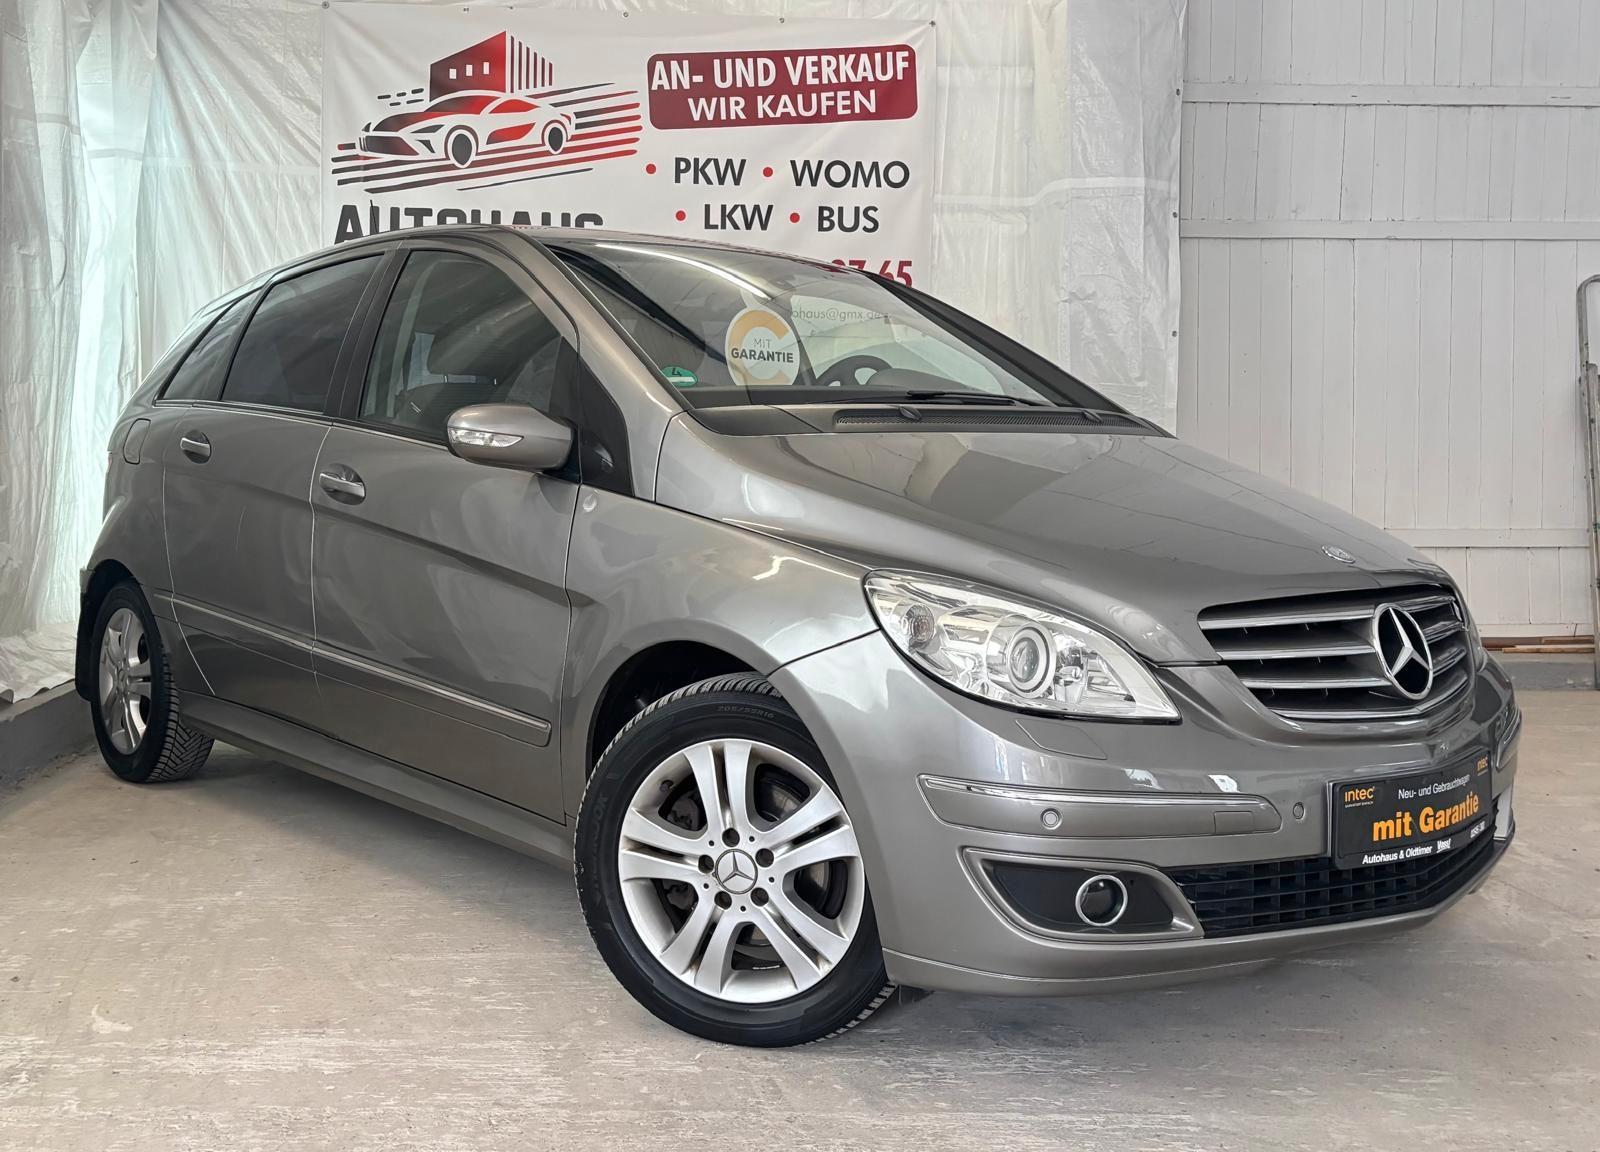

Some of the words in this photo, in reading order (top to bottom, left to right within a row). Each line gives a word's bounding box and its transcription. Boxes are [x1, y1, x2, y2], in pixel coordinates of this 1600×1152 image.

[651, 59, 704, 91] AN-
[713, 55, 776, 89] UND
[783, 51, 910, 85] VERKAUF
[687, 95, 752, 121] WIR
[756, 90, 877, 118] KAUFEN
[674, 158, 747, 186] PKW
[790, 160, 910, 189] WOMO
[703, 204, 774, 231] LKW
[816, 205, 880, 234] BUS
[730, 347, 794, 364] GARANTIE
[753, 338, 772, 349] MIT
[671, 367, 683, 377] 4
[1398, 789, 1417, 800] Neu-
[1418, 784, 1432, 797] und
[1433, 774, 1471, 794] Gebrauchtwagen
[1373, 811, 1412, 842] mit
[1419, 791, 1480, 834] Garantie
[1362, 853, 1398, 865] Autohaus
[1399, 849, 1405, 859] &
[1405, 846, 1433, 858] Oldtimer
